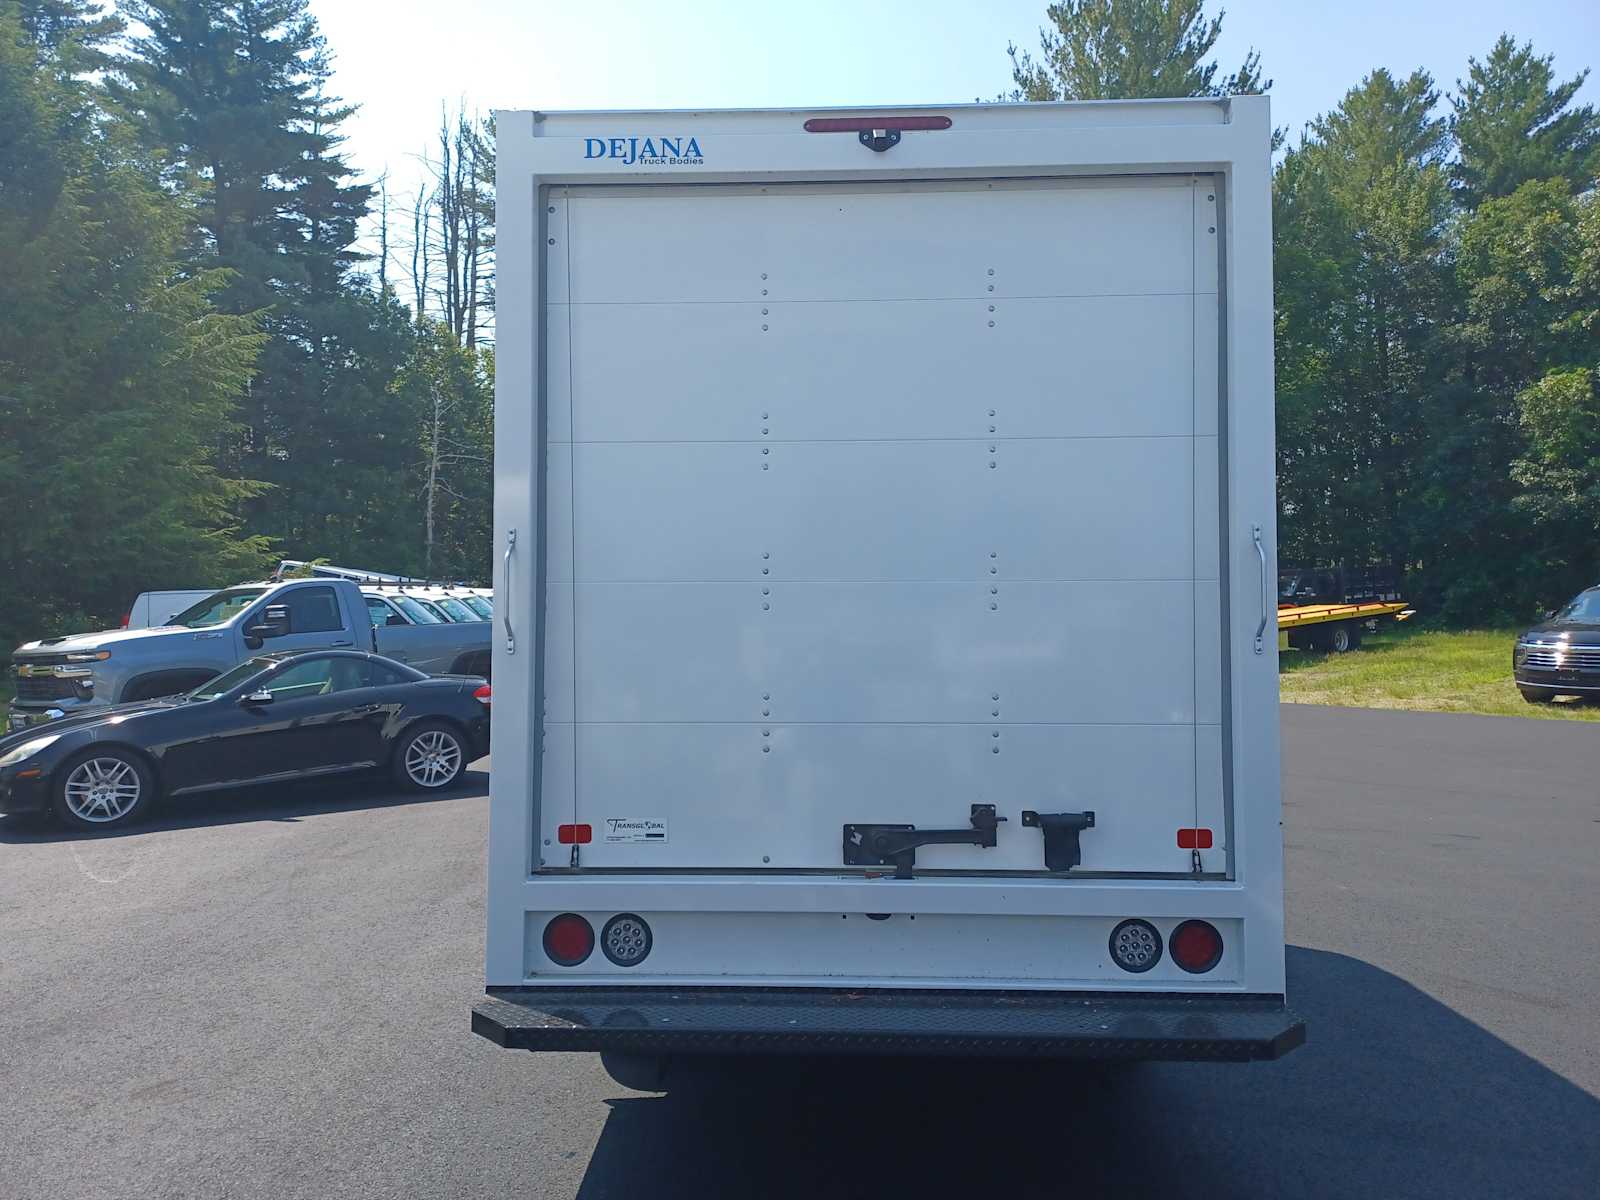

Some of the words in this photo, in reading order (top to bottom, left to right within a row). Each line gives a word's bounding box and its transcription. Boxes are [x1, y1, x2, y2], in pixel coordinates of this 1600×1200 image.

[584, 137, 704, 165] DEJANA
[639, 157, 667, 165] Truck
[669, 157, 704, 165] Bodies
